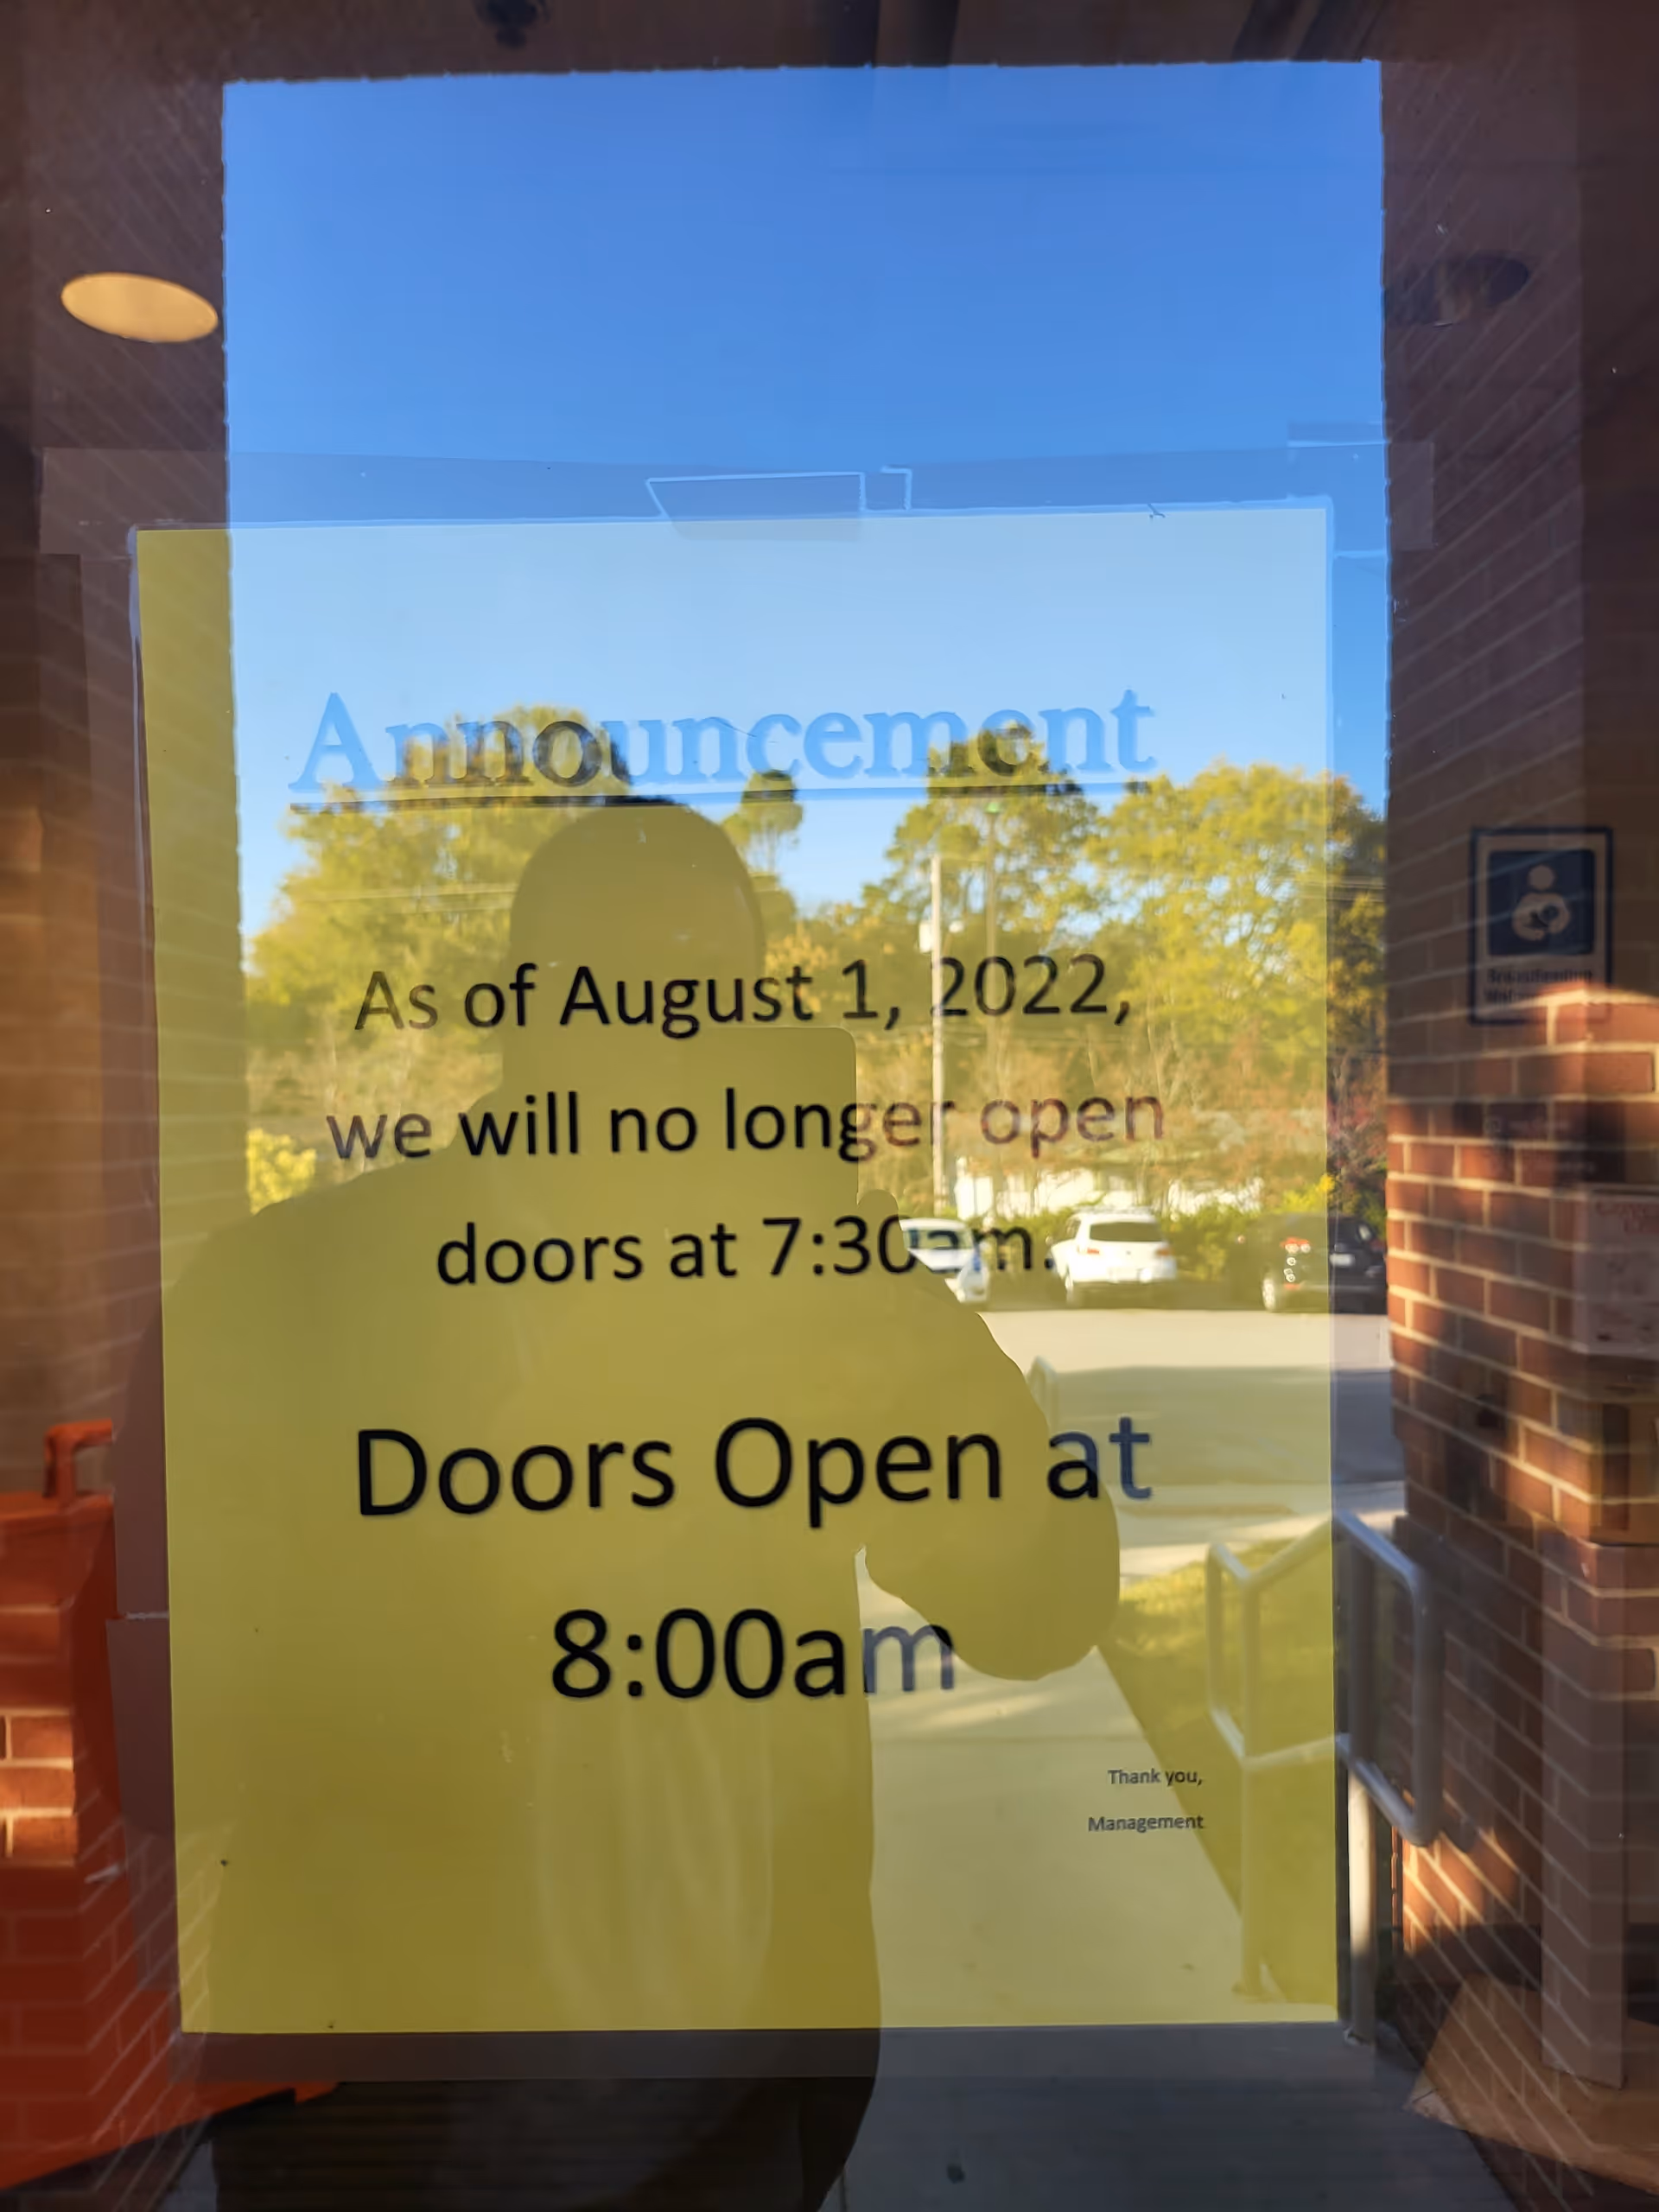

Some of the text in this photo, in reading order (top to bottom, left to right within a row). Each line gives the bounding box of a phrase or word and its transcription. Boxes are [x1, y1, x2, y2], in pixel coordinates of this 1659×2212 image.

[288, 689, 1158, 792] Announcement
[354, 954, 1132, 1039] As of August 1, 2022,
[326, 1088, 1164, 1164] we will no longer open
[437, 1221, 644, 1285] doors
[670, 1223, 739, 1279] at
[358, 1416, 1153, 1529] Doors Open at
[551, 1608, 954, 1700] 8:00am
[1108, 1768, 1203, 1788] Thank you,
[1088, 1815, 1204, 1834] Management
